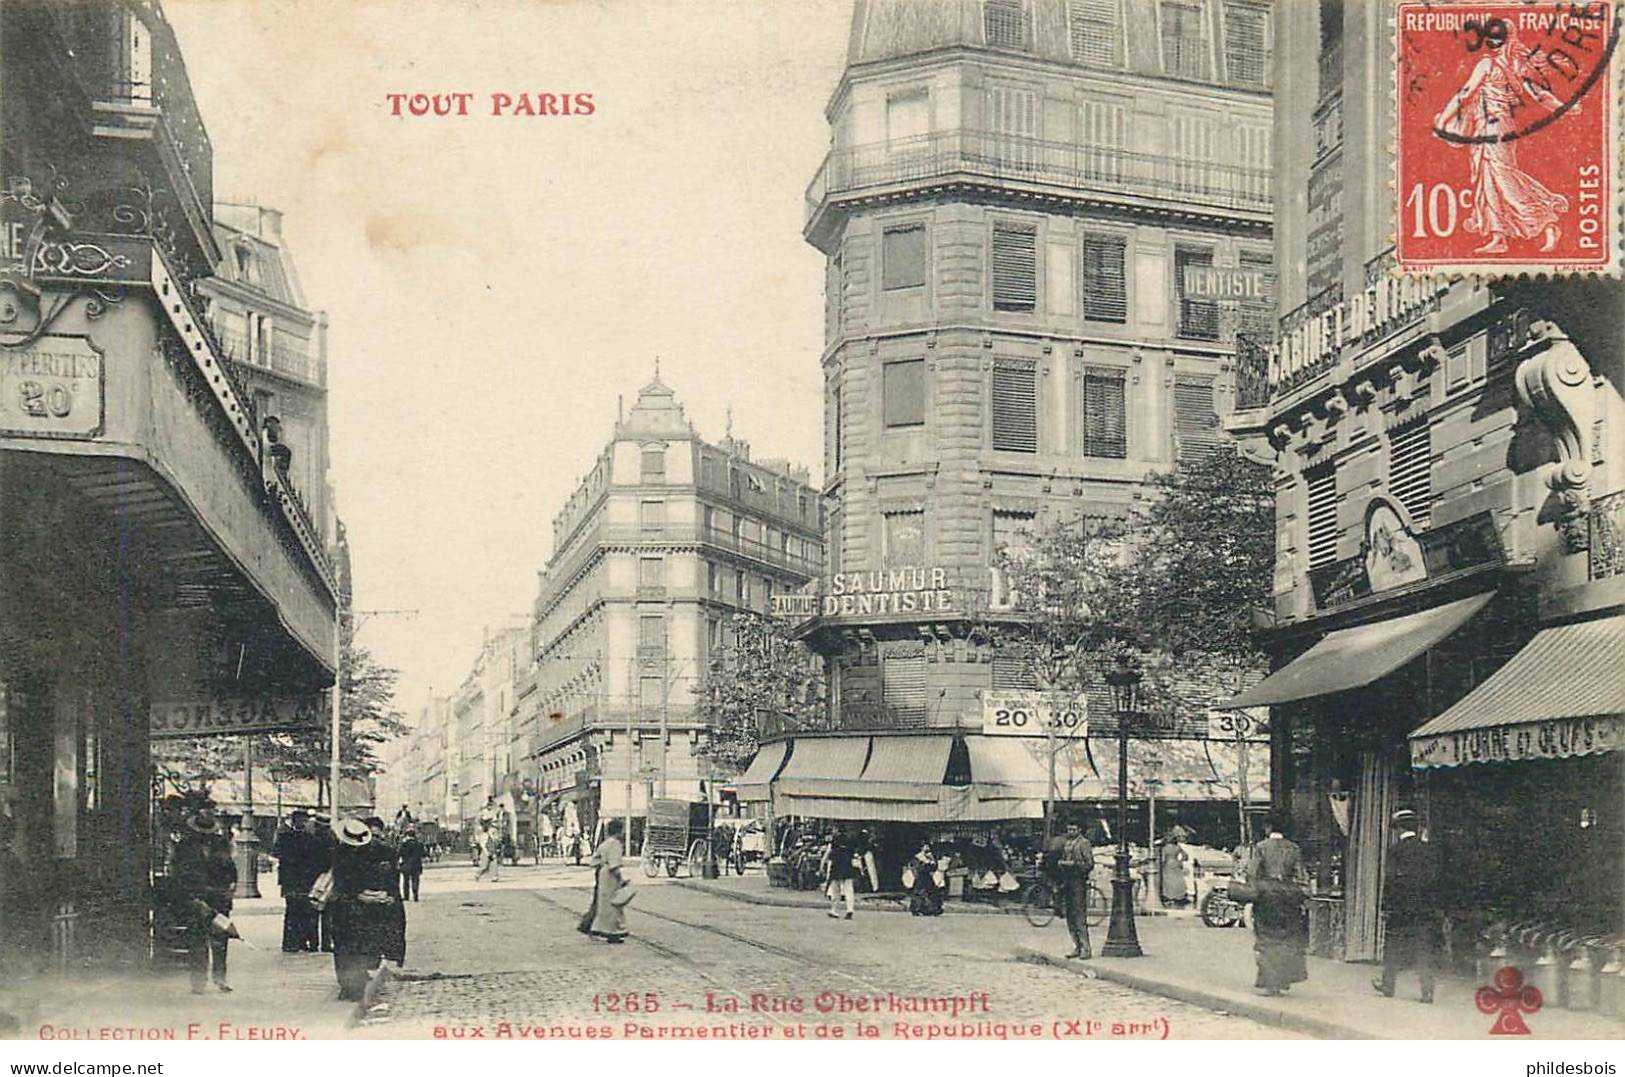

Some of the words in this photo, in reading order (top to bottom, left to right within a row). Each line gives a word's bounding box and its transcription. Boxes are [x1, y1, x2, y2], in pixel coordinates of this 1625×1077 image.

[1579, 164, 1601, 249] POSTES
[1184, 270, 1263, 297] DENTISTE
[833, 567, 947, 595] SAUMUR
[825, 590, 951, 615] DENTISTE
